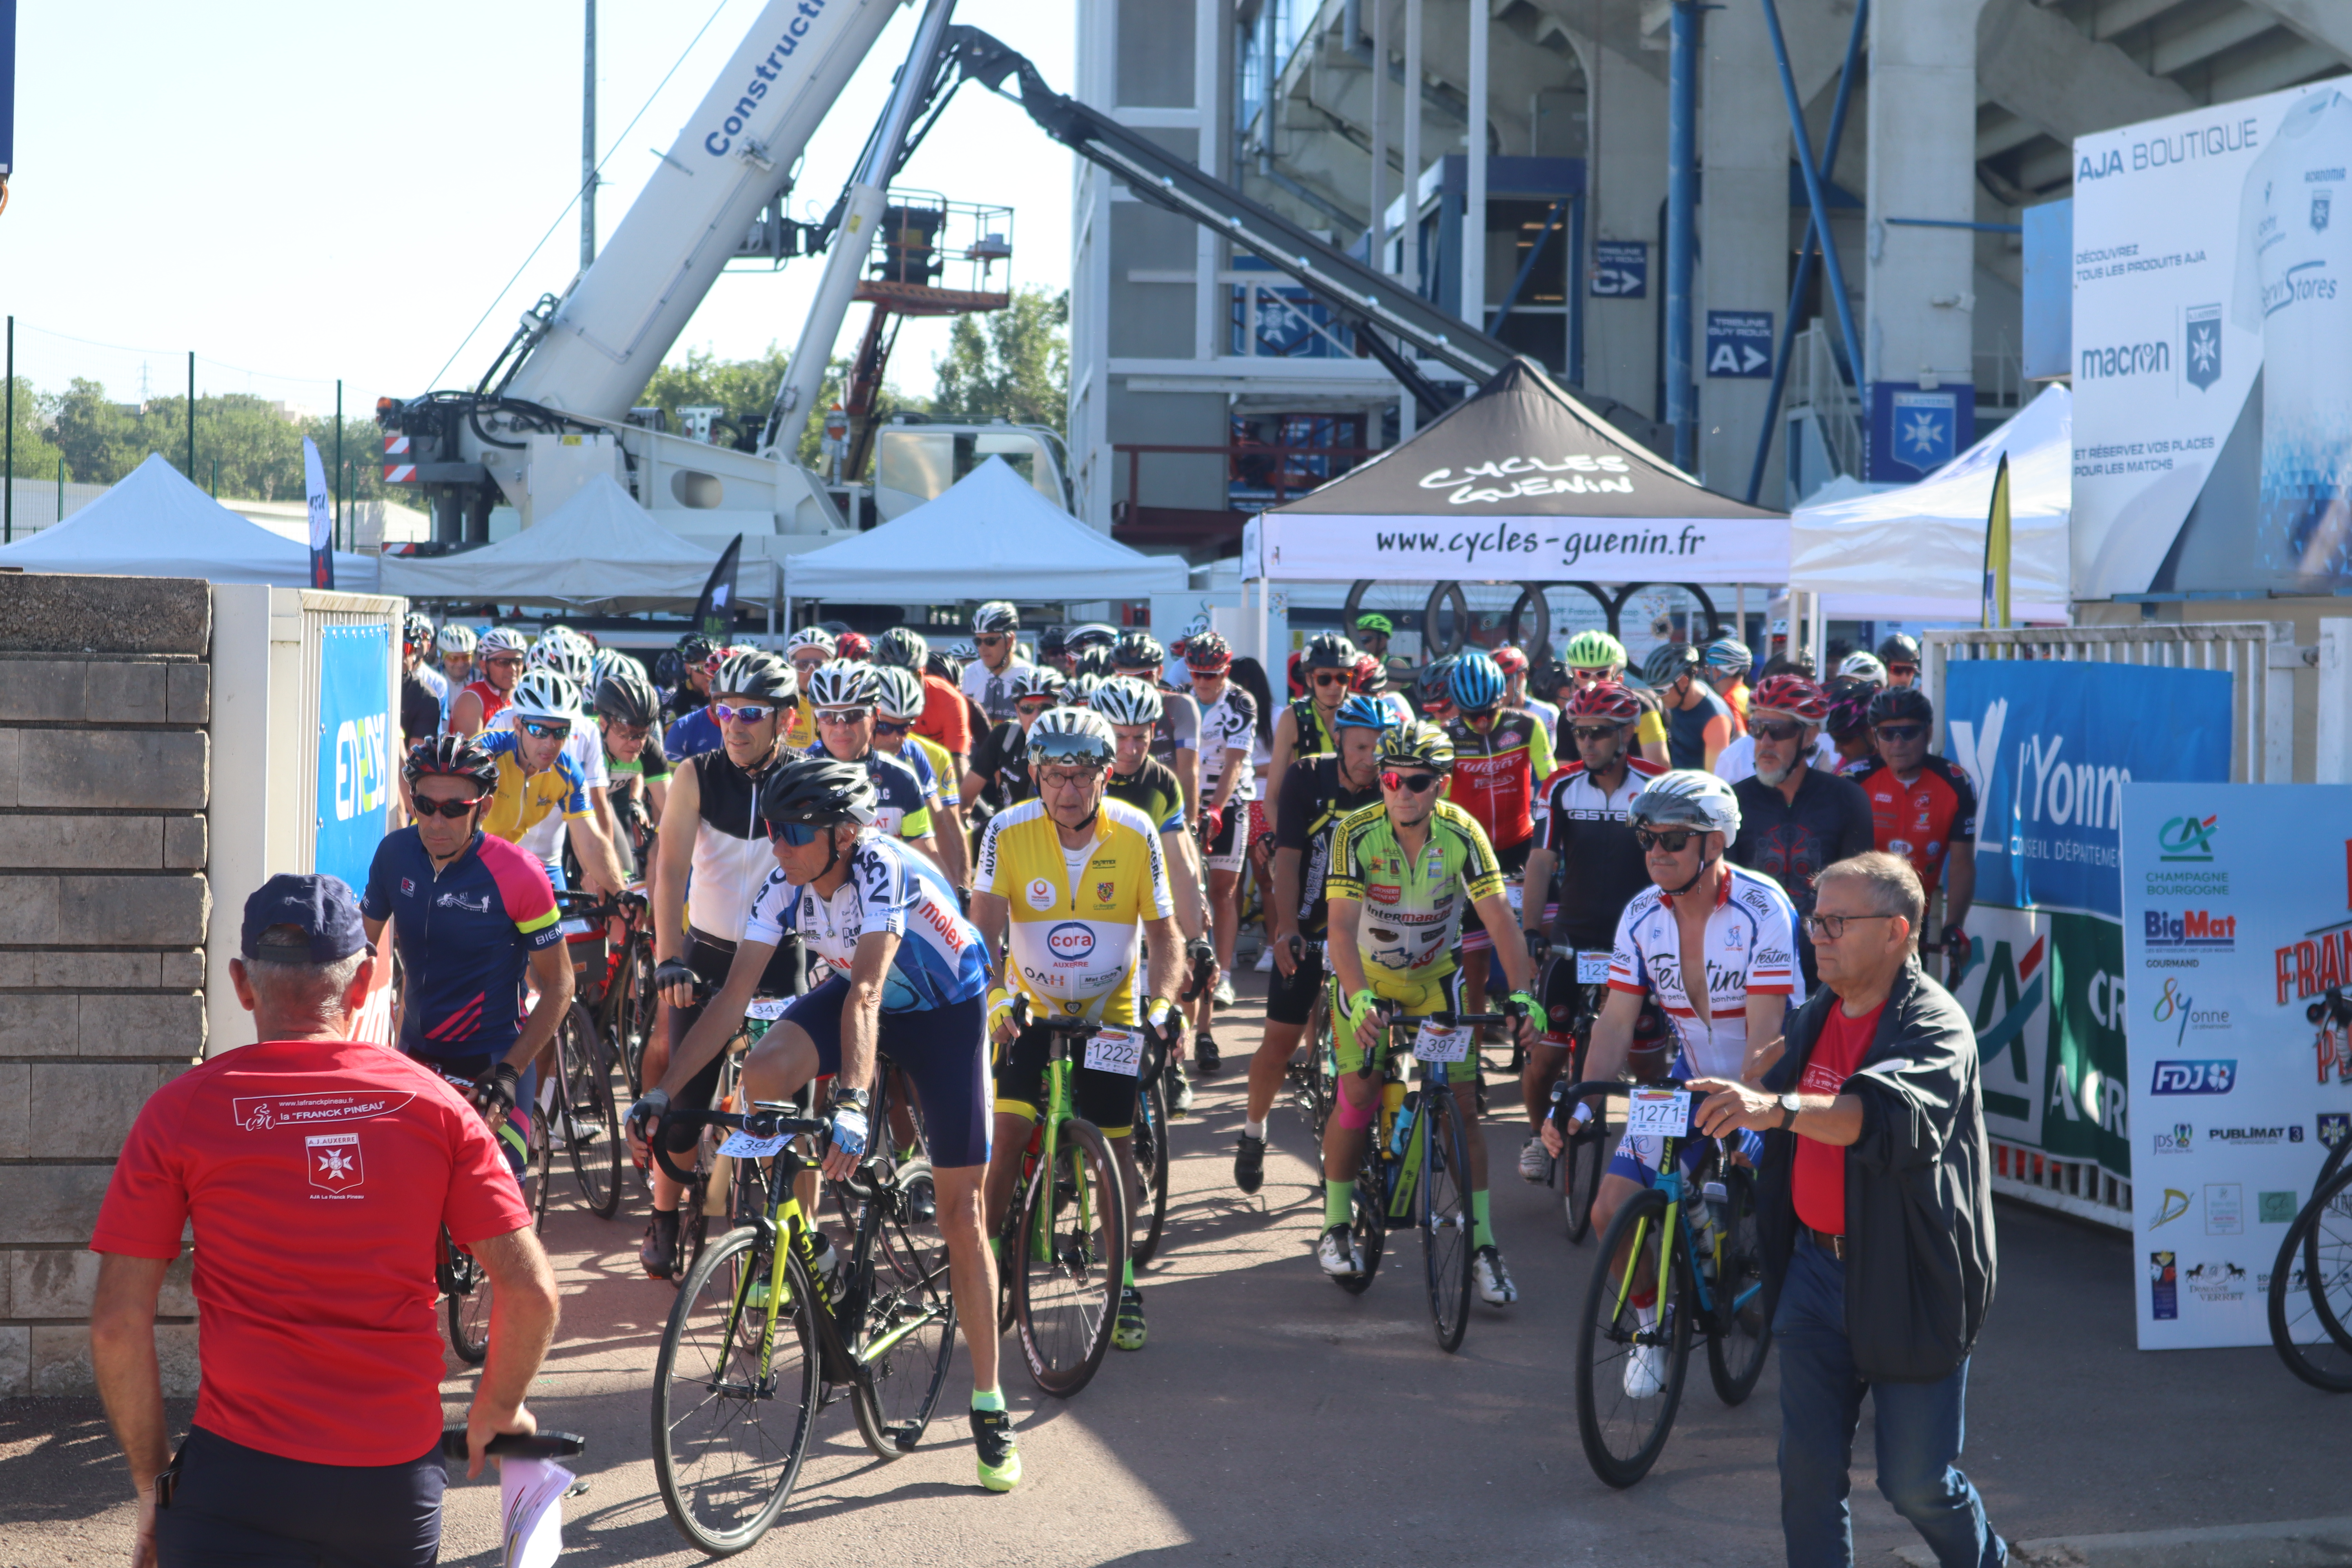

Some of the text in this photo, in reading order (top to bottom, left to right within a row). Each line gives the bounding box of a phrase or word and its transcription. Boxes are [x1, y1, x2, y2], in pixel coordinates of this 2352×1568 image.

[2077, 119, 2258, 183] AJA BOUTIQUE
[2077, 244, 2138, 265] DÉCOUVREZ
[2077, 249, 2207, 281] TOUS LES PRODUITS AJA
[1592, 269, 1619, 293] C
[1708, 327, 1771, 337] GUY ROUX
[1714, 318, 1767, 327] TRIBUNE
[1710, 344, 1740, 372] A
[2082, 341, 2169, 379] macron
[2074, 437, 2215, 460] ET RÉSERVEZ VOS PLACES
[1419, 454, 1630, 488] CYCLES
[2074, 458, 2173, 477] POUR LES MATCHS
[1377, 523, 1706, 565] www.cycles-guenin.fr
[1345, 812, 1372, 826] LEVAGE
[2011, 836, 2120, 867] CONSEIL DÉPARTEME
[2146, 872, 2229, 882] CHAMPAGNE
[2147, 885, 2229, 895] BOURGOGNE
[918, 901, 965, 955] molex
[2145, 910, 2236, 946] BigMat
[1051, 935, 1092, 947] cora
[2146, 959, 2200, 968] GOURMAND
[1100, 971, 1118, 980] Cichy
[1711, 995, 1747, 1004] bonheur
[753, 1004, 785, 1015] 346
[1094, 1043, 1134, 1064] 1222
[1426, 1039, 1455, 1053] 397
[2156, 1066, 2205, 1091] FDJ
[279, 1097, 354, 1107] www.lafranckpineau.fr
[292, 1109, 342, 1120] "FRANCK
[344, 1100, 386, 1115] PINEAU"
[1638, 1105, 1679, 1123] 1271
[308, 1136, 356, 1145] A.J.AUXERRE
[739, 1140, 775, 1151] 394
[2200, 1292, 2245, 1302] VERRET
[1085, 1291, 1108, 1362] GIANT
[1020, 1324, 1042, 1376] GIANT
